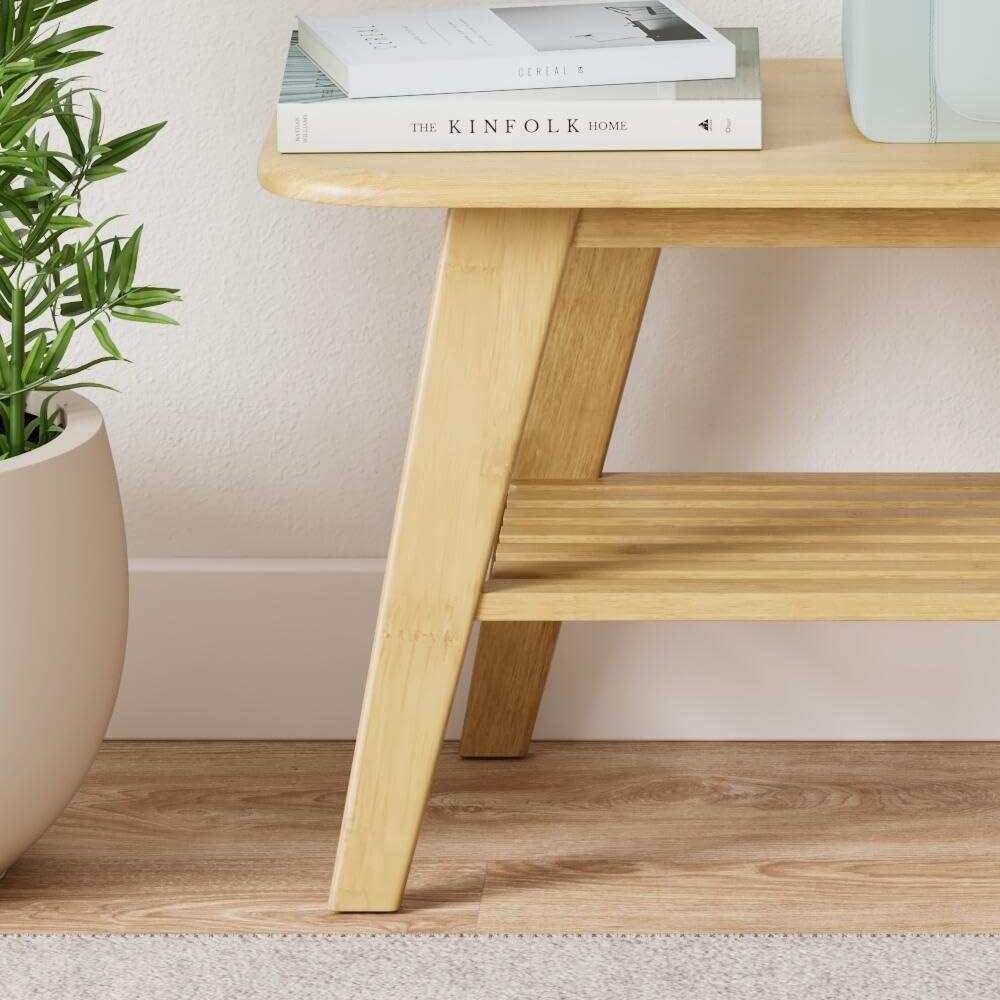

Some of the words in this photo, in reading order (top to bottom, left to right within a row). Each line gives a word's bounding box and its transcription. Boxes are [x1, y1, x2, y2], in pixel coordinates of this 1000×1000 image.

[518, 65, 568, 78] CEREAL
[411, 122, 437, 133] THE
[449, 118, 580, 134] KINFOLK
[588, 121, 628, 131] HOME
